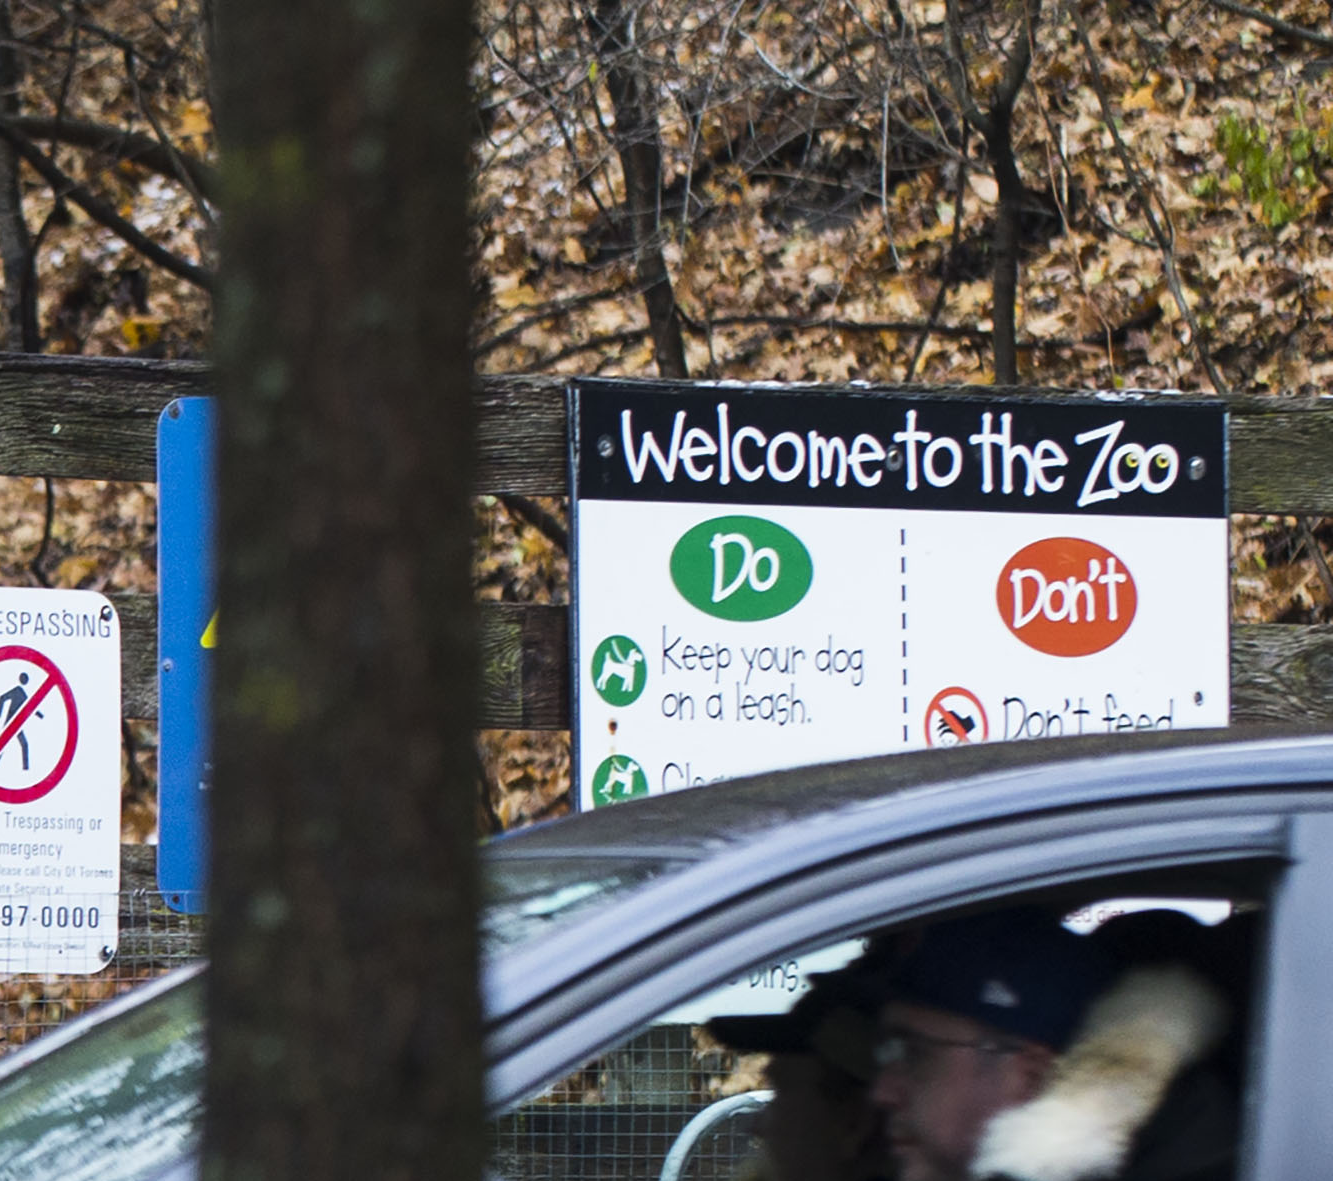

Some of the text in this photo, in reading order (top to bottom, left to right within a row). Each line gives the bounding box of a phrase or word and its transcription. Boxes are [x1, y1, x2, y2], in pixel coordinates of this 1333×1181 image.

[620, 402, 1180, 507] Welcome to the Zoo
[710, 531, 780, 603] Do
[1009, 557, 1127, 630] Don't
[661, 625, 864, 687] Keep your dog
[661, 681, 812, 726] on a leash.
[1002, 693, 1174, 740] Don't feed
[4, 811, 84, 834] Trespassing
[89, 817, 103, 831] or
[24, 864, 42, 876] call
[43, 865, 62, 878] City
